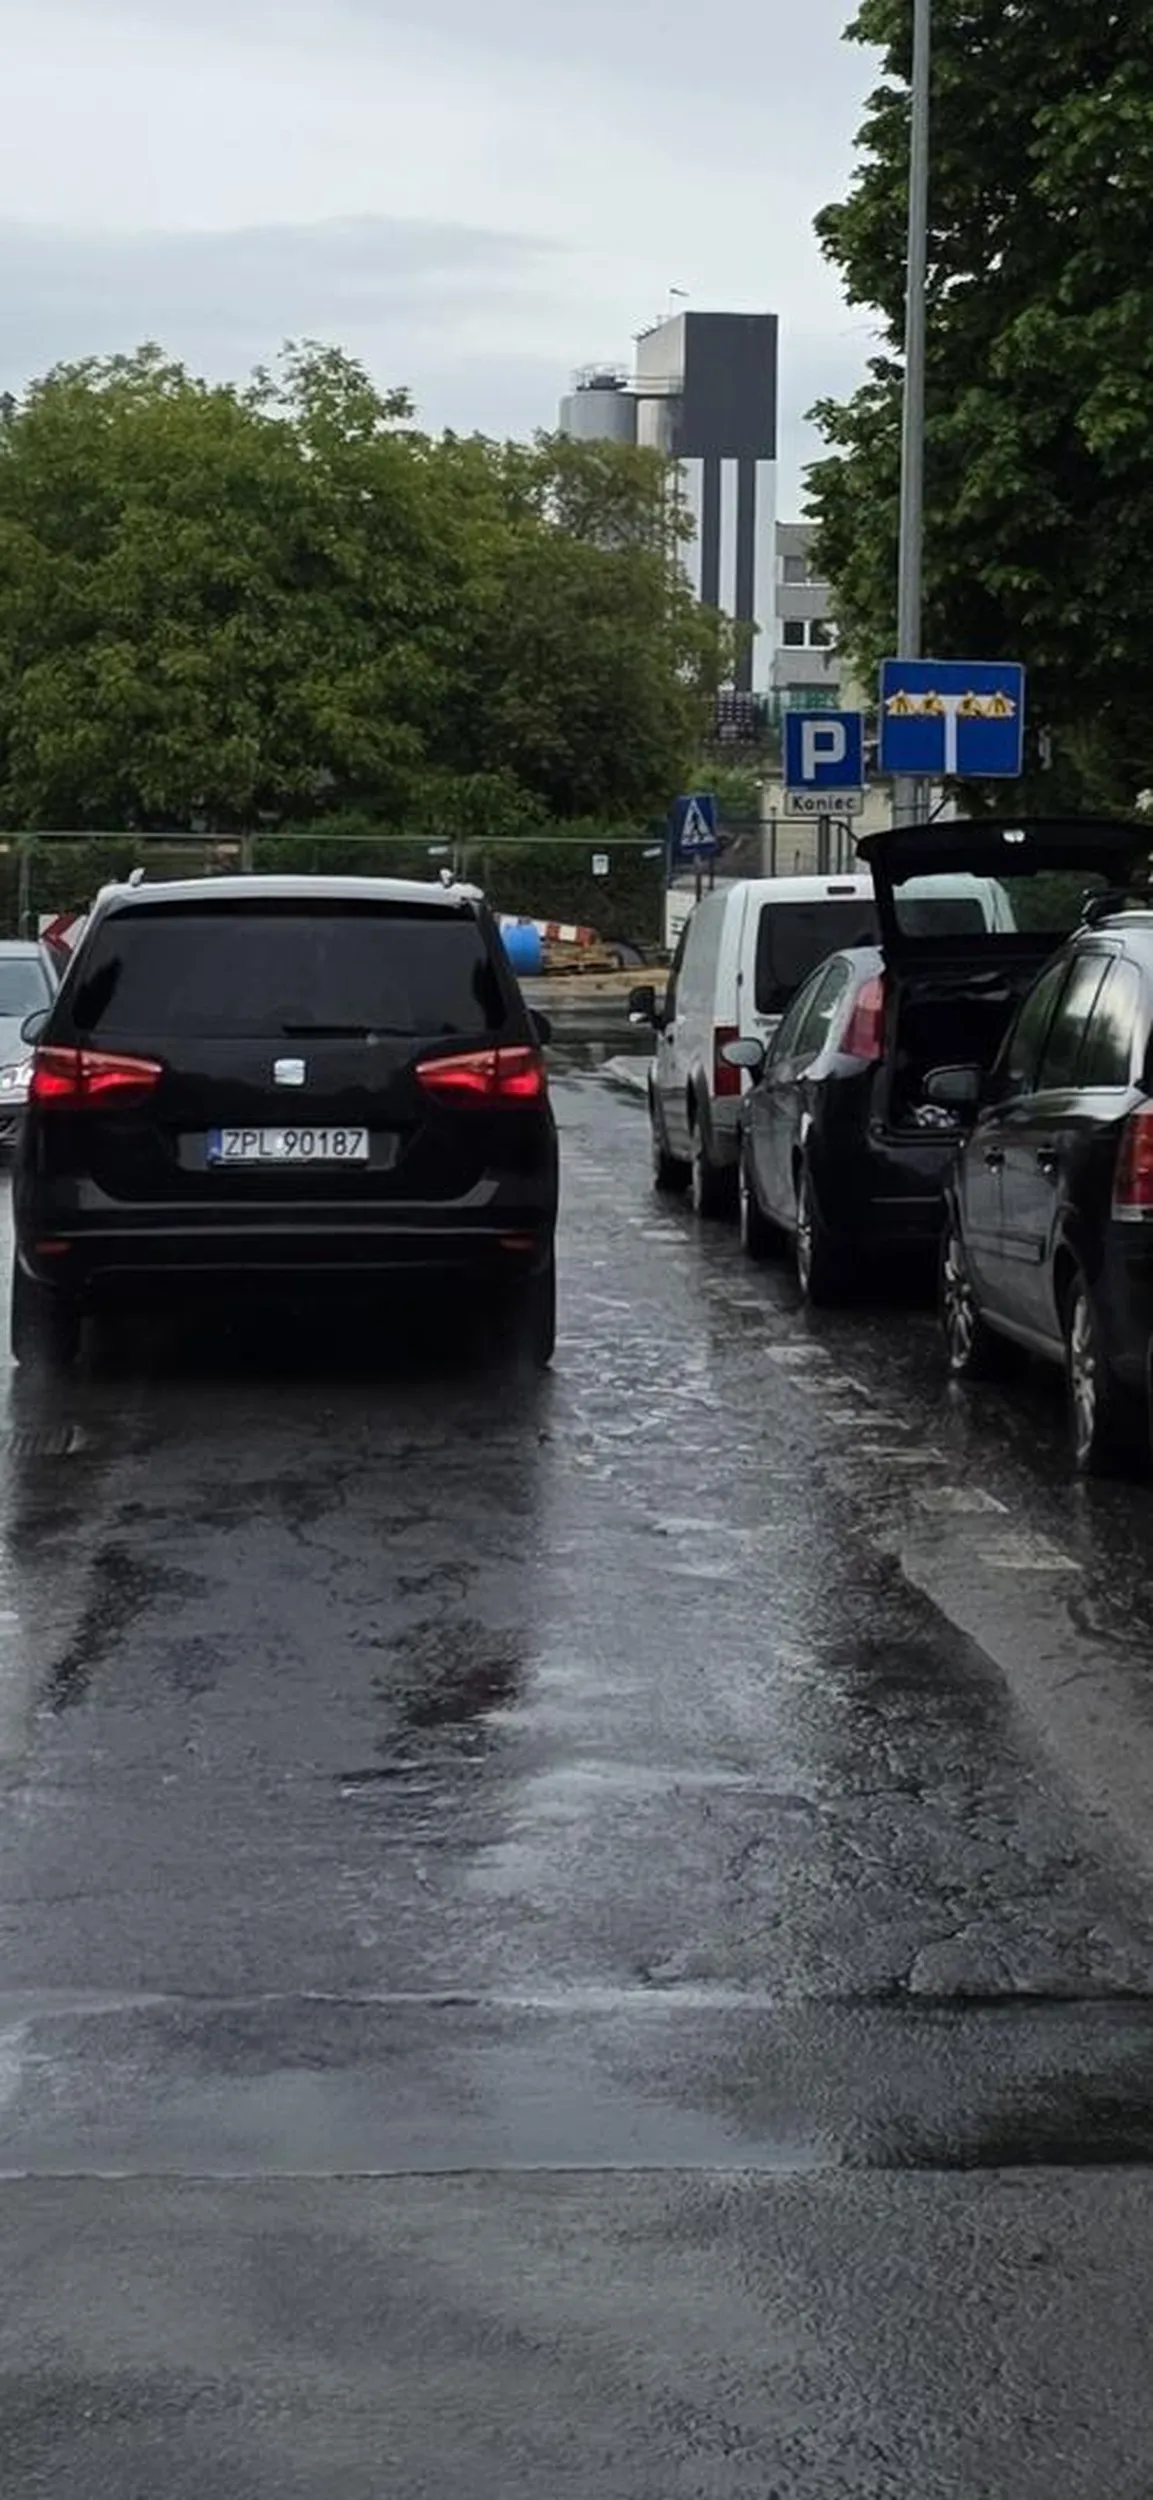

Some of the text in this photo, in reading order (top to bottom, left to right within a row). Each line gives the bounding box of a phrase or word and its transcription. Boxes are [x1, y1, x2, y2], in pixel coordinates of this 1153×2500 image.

[801, 720, 846, 779] P
[793, 795, 857, 812] Koniec
[224, 1131, 273, 1156] ZPL
[283, 1130, 363, 1156] 90187
